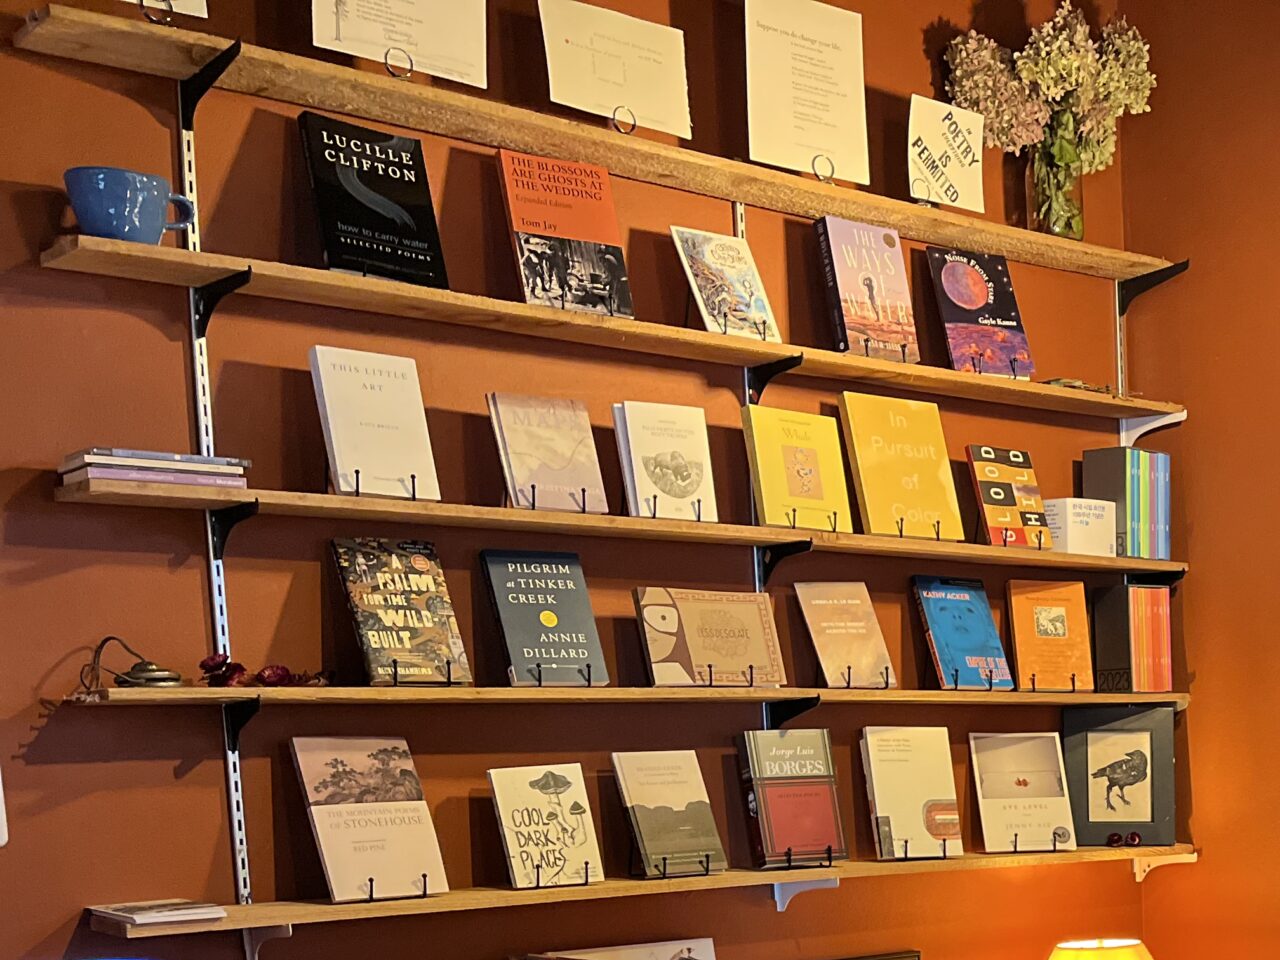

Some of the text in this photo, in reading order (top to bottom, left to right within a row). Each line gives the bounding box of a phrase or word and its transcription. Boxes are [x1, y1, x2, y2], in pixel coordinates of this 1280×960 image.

[321, 130, 413, 165] LUCILLE
[942, 111, 979, 167] POETRY
[324, 150, 416, 183] CLIFTON
[510, 156, 600, 180] THE BLOSSOMS
[938, 150, 951, 168] IS
[912, 136, 959, 203] PERMITTED
[511, 168, 604, 191] ARE GHOSTS AT
[513, 178, 602, 200] THE WEDDING
[520, 217, 557, 232] Tom Jay
[337, 221, 429, 249] how carry water
[340, 236, 391, 253] SELECTED
[852, 228, 877, 248] THE
[842, 244, 896, 275] WAYS
[944, 253, 969, 265] NOISE
[845, 298, 909, 324] WATER
[331, 362, 408, 381] THIS LITTLE
[361, 381, 384, 393] ART
[888, 409, 907, 429] In
[870, 435, 937, 461] Pursuit
[901, 472, 920, 491] of
[891, 502, 940, 525] Color
[391, 554, 401, 569] A
[507, 563, 570, 574] PILGRIM
[375, 572, 436, 592] PSALM
[517, 579, 576, 590] TINKER
[363, 593, 408, 606] FOR THE
[508, 593, 557, 604] CREEK
[922, 591, 970, 601] KATHY ACKER
[376, 609, 438, 629] WILD-
[367, 630, 411, 649] BUILT
[540, 633, 587, 643] ANNIE
[523, 648, 588, 659] DILLARD
[1100, 670, 1130, 692] 2023
[769, 746, 814, 758] Jorge Luis
[765, 760, 825, 774] BORGES
[343, 815, 424, 830] STONEHOUSE
[511, 807, 549, 828] COOL
[515, 830, 556, 848] DARK
[520, 847, 566, 870] PLACES
